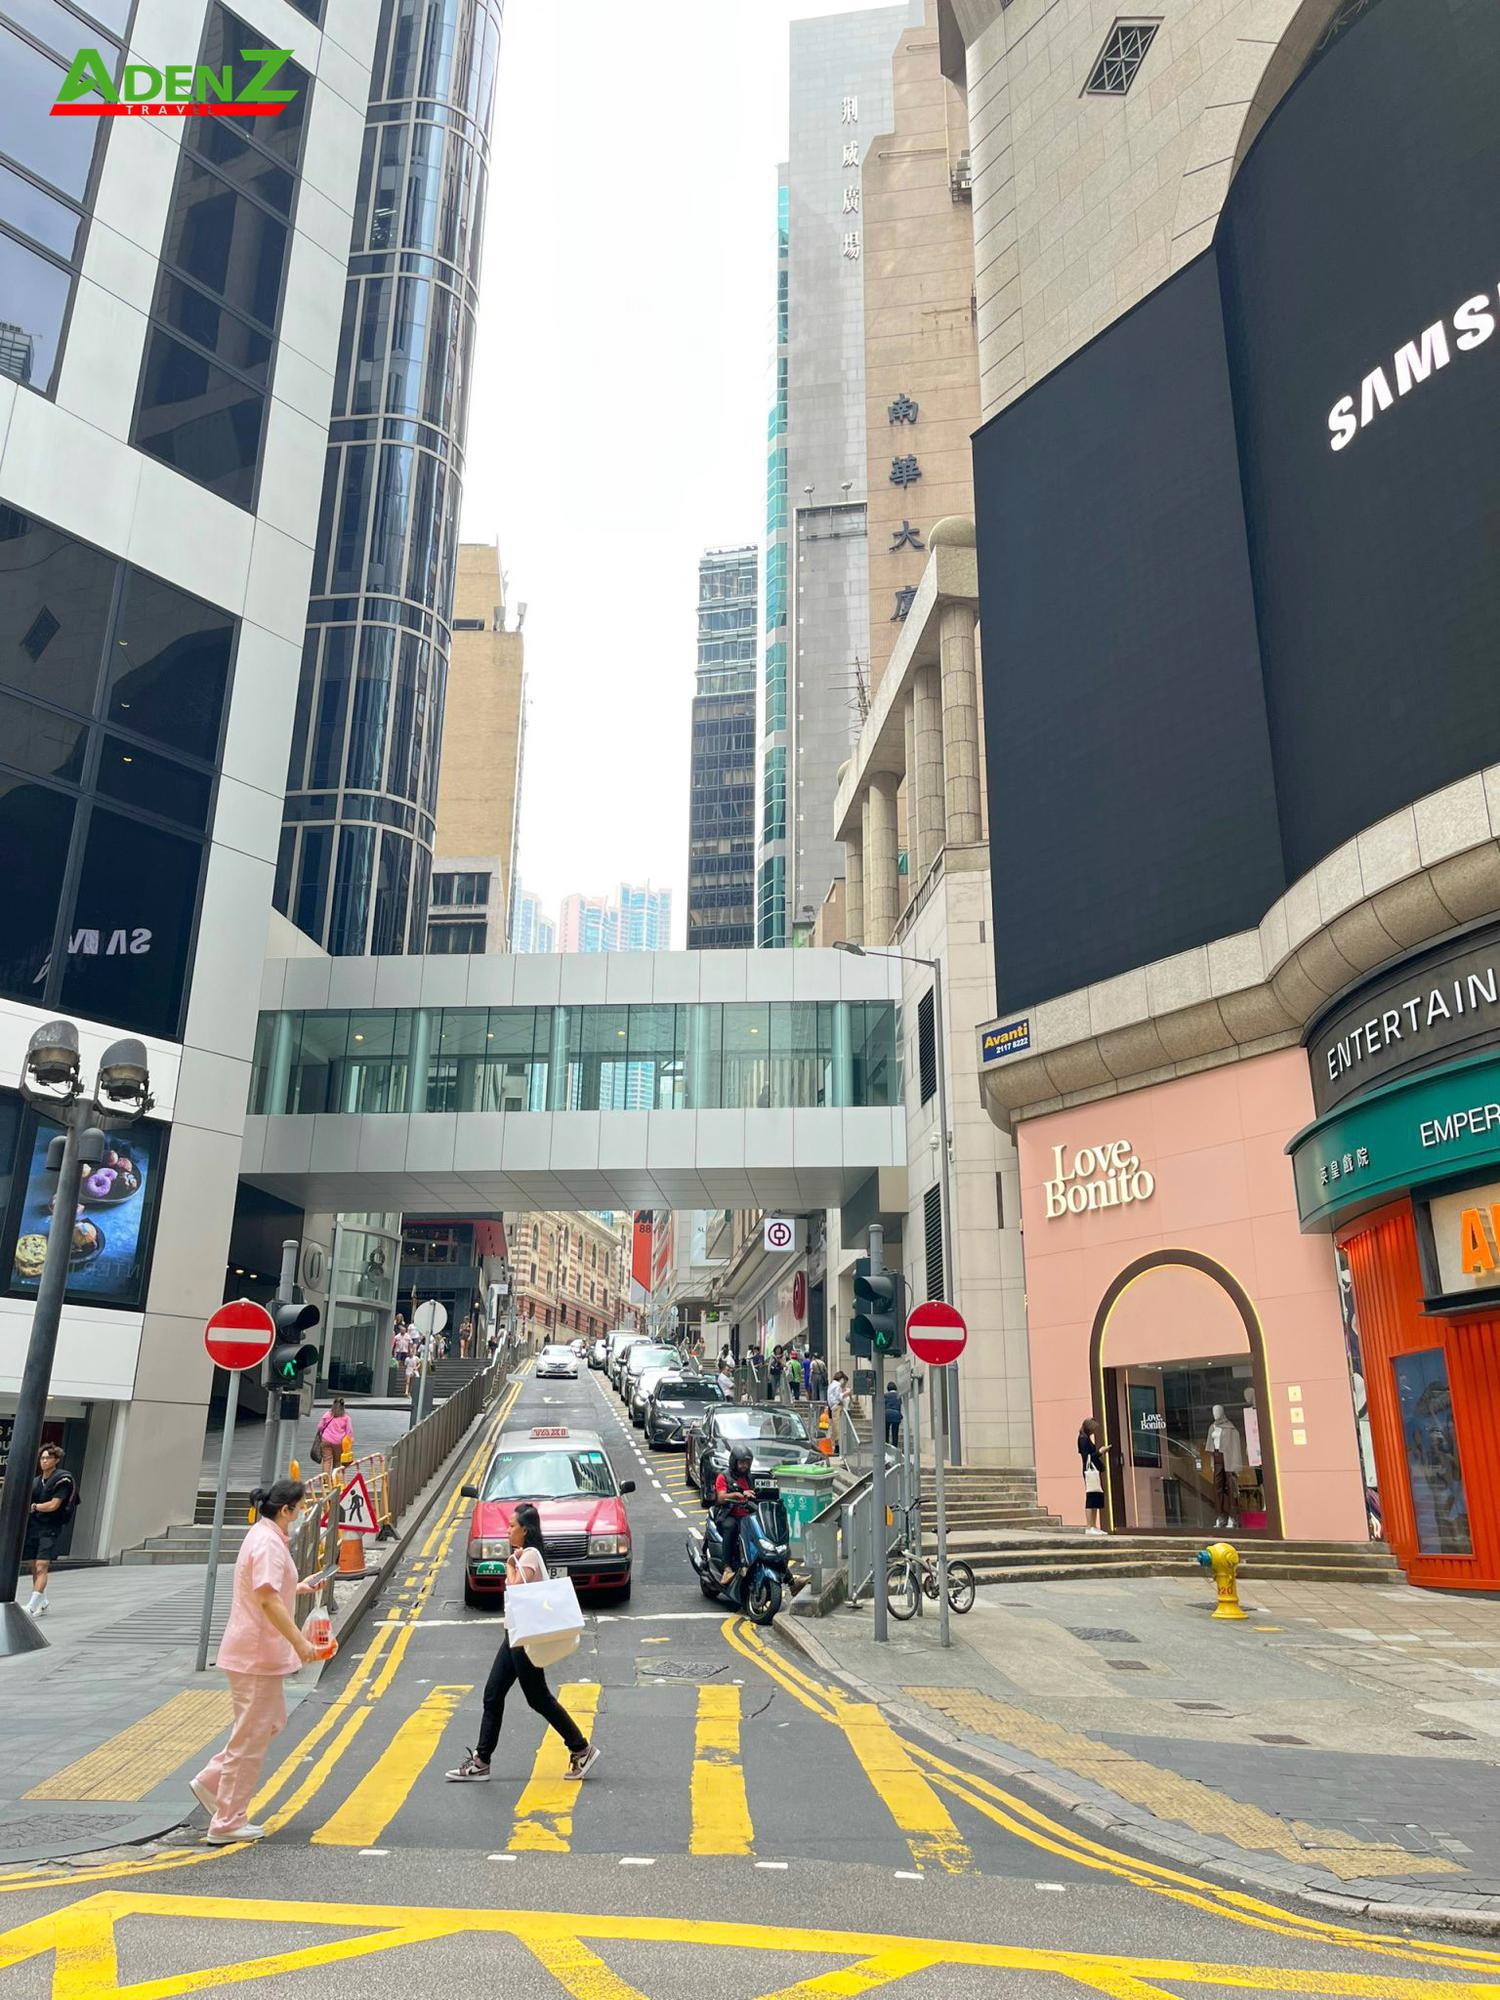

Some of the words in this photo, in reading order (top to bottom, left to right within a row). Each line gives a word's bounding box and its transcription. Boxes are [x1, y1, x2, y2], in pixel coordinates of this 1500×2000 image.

[1328, 280, 1500, 451] SAMS
[984, 1022, 1028, 1048] Avanti
[1327, 968, 1499, 1081] ENTERTAIN
[996, 1043, 1011, 1054] 2117
[1051, 1139, 1140, 1182] Love,
[1043, 1166, 1155, 1217] Bonito
[1141, 1420, 1166, 1430] Bonito
[1142, 1412, 1163, 1423] Love,
[533, 1428, 566, 1437] TAXI
